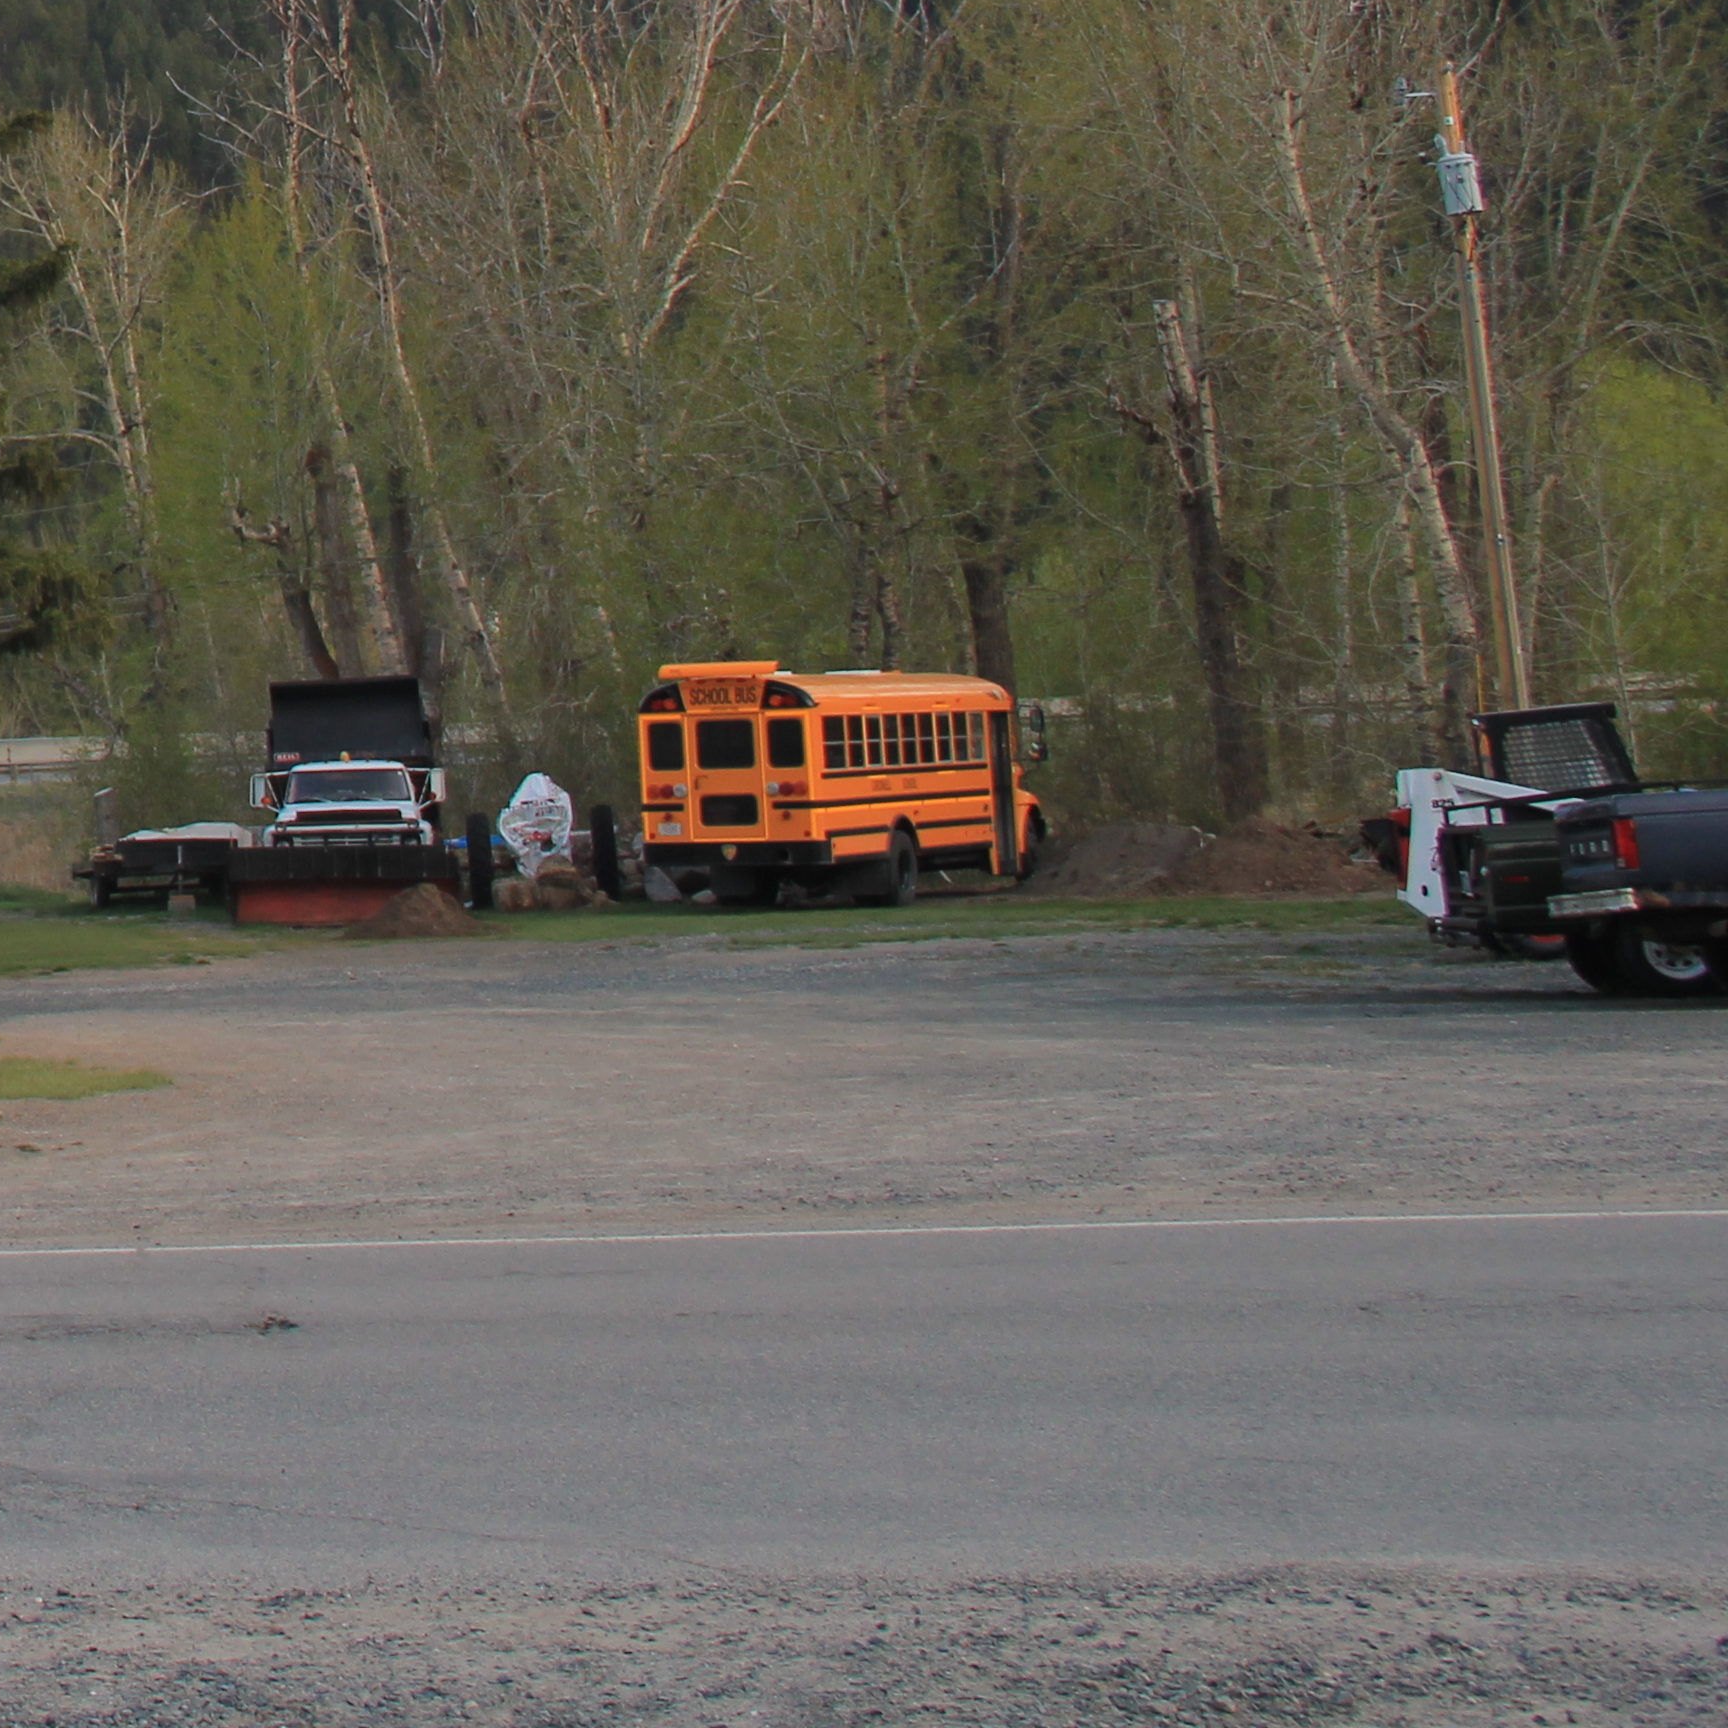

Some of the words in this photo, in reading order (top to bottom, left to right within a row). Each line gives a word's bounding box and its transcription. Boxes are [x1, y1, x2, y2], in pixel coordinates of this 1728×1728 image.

[689, 687, 732, 706] SCHOOL
[735, 685, 757, 704] BUS
[1569, 839, 1610, 856] FORD
